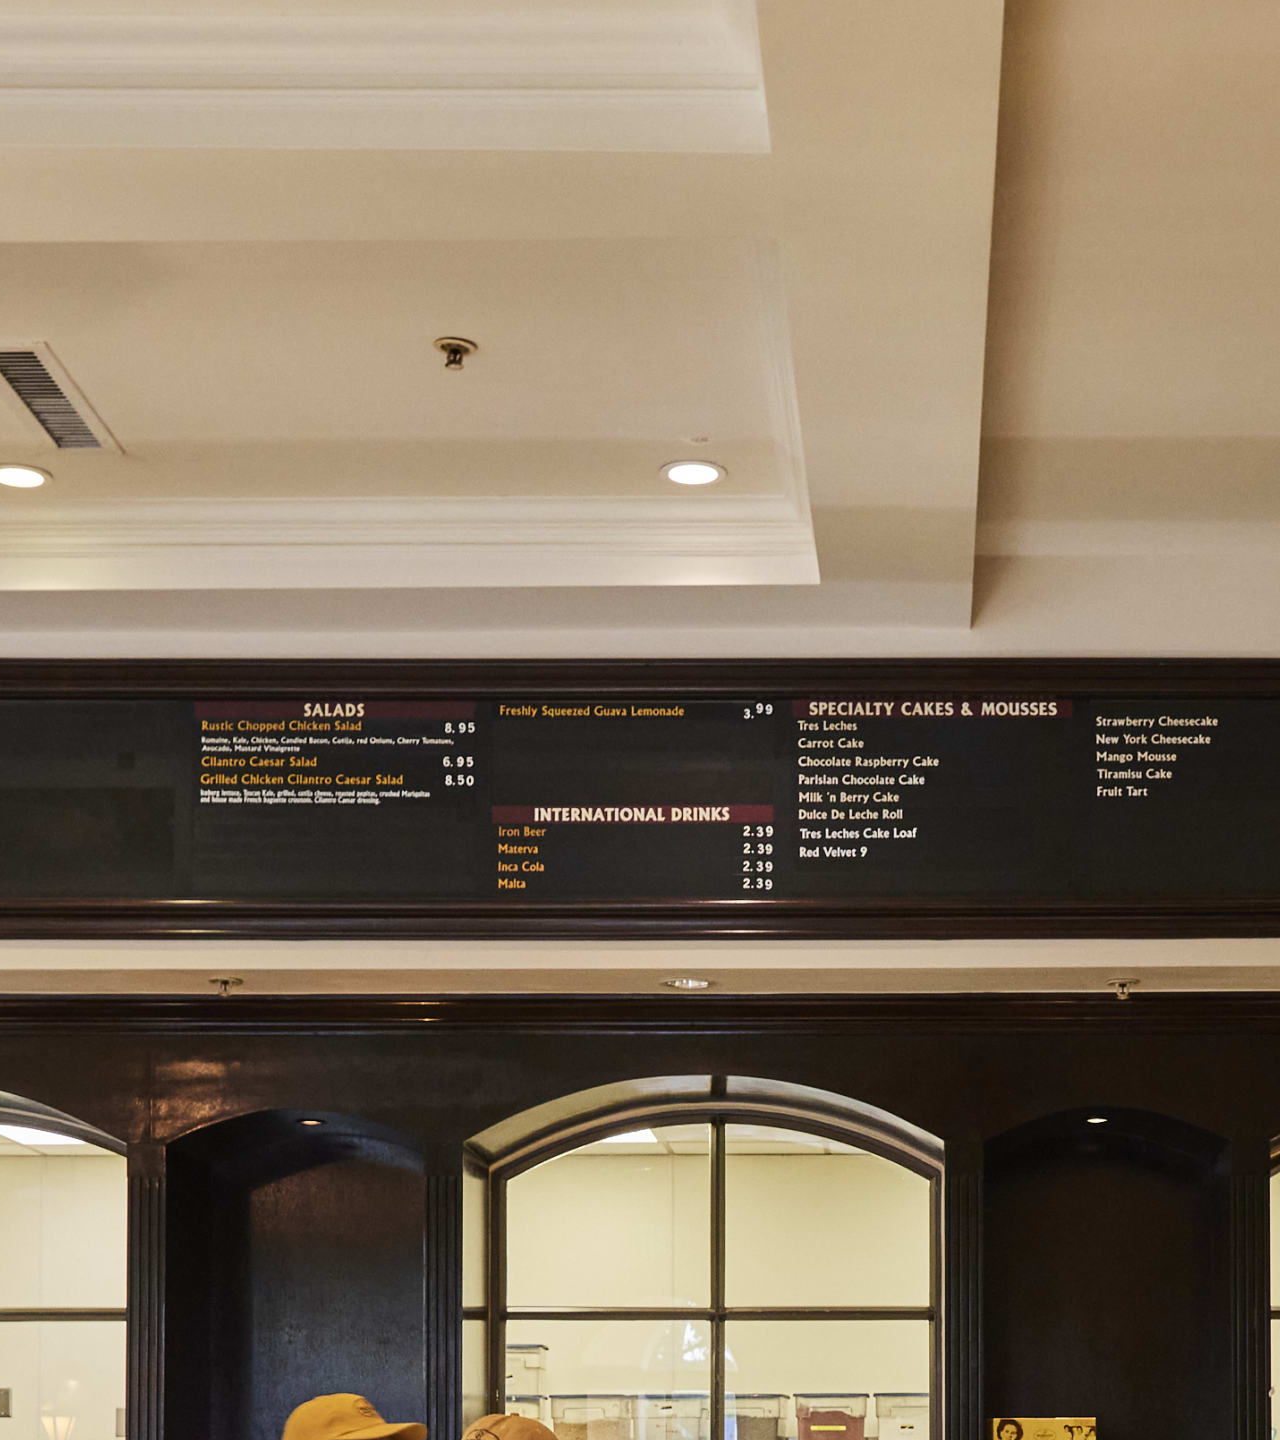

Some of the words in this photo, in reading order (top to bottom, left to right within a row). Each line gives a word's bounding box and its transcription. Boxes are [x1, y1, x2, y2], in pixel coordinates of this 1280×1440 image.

[304, 703, 365, 717] SALADS
[500, 705, 538, 718] Freshly
[542, 705, 590, 718] Squeezed
[594, 705, 627, 717] Guava
[631, 706, 685, 717] Lemonade
[743, 703, 773, 719] 3.99
[809, 701, 894, 716] SPECIALTY
[901, 702, 954, 716] CAKES
[961, 702, 973, 716] &
[981, 702, 1058, 716] MOUSSES
[201, 720, 234, 731] Rustic
[237, 720, 285, 732] Chopped
[289, 720, 331, 731] Chicken
[334, 720, 362, 731] Salad
[444, 722, 475, 734] 8.95
[797, 720, 819, 731] Tres
[823, 720, 858, 731] Leches
[1096, 716, 1155, 728] Strawberry
[1158, 716, 1218, 727] Cheesecake
[797, 738, 834, 749] Carrot
[837, 738, 864, 749] Cake
[1096, 734, 1119, 744] New
[1123, 734, 1147, 744] York
[1151, 733, 1211, 744] Cheesecake
[201, 756, 246, 767] Cilantro
[249, 756, 285, 767] Caesar
[289, 756, 317, 767] Salad
[443, 756, 474, 768] 6.95
[798, 756, 852, 767] Chocolate
[855, 756, 909, 768] Raspberry
[912, 756, 939, 767] Cake
[1096, 751, 1133, 763] Mango
[1137, 751, 1177, 762] Mousse
[200, 773, 238, 785] Grilled
[241, 773, 284, 785] Chicken
[287, 774, 332, 785] Cilantro
[335, 774, 371, 785] Caesar
[376, 774, 403, 785] Salad
[445, 774, 474, 786] 8.50
[798, 774, 839, 785] Parisian
[842, 774, 895, 785] Chocolate
[898, 774, 925, 785] Cake
[1097, 768, 1142, 779] Tiramisu
[1145, 768, 1172, 779] Cake
[798, 792, 823, 803] Milk
[840, 792, 870, 804] Berry
[872, 791, 899, 802] Cake
[1097, 786, 1122, 797] Fruit
[1126, 786, 1148, 796] Tart
[534, 807, 666, 822] INTERNATIONAL
[671, 807, 730, 822] DRINKS
[798, 809, 828, 820] Dulce
[831, 809, 845, 820] De
[849, 809, 879, 820] Leche
[882, 809, 903, 820] Roll
[498, 826, 520, 837] Iron
[523, 826, 546, 837] Beer
[743, 825, 774, 837] 2.39
[799, 828, 822, 839] Tres
[825, 828, 860, 839] Leches
[863, 827, 890, 839] Cake
[893, 827, 917, 838] Loaf
[498, 843, 538, 854] Materva
[743, 842, 773, 855] 2.39
[799, 846, 820, 858] Red
[823, 846, 857, 857] Velvet
[860, 846, 868, 857] 9
[498, 861, 518, 872] Inca
[522, 861, 545, 872] Cola
[743, 860, 773, 873] 2.39
[498, 878, 526, 889] Malta
[743, 877, 773, 890] 2.39
